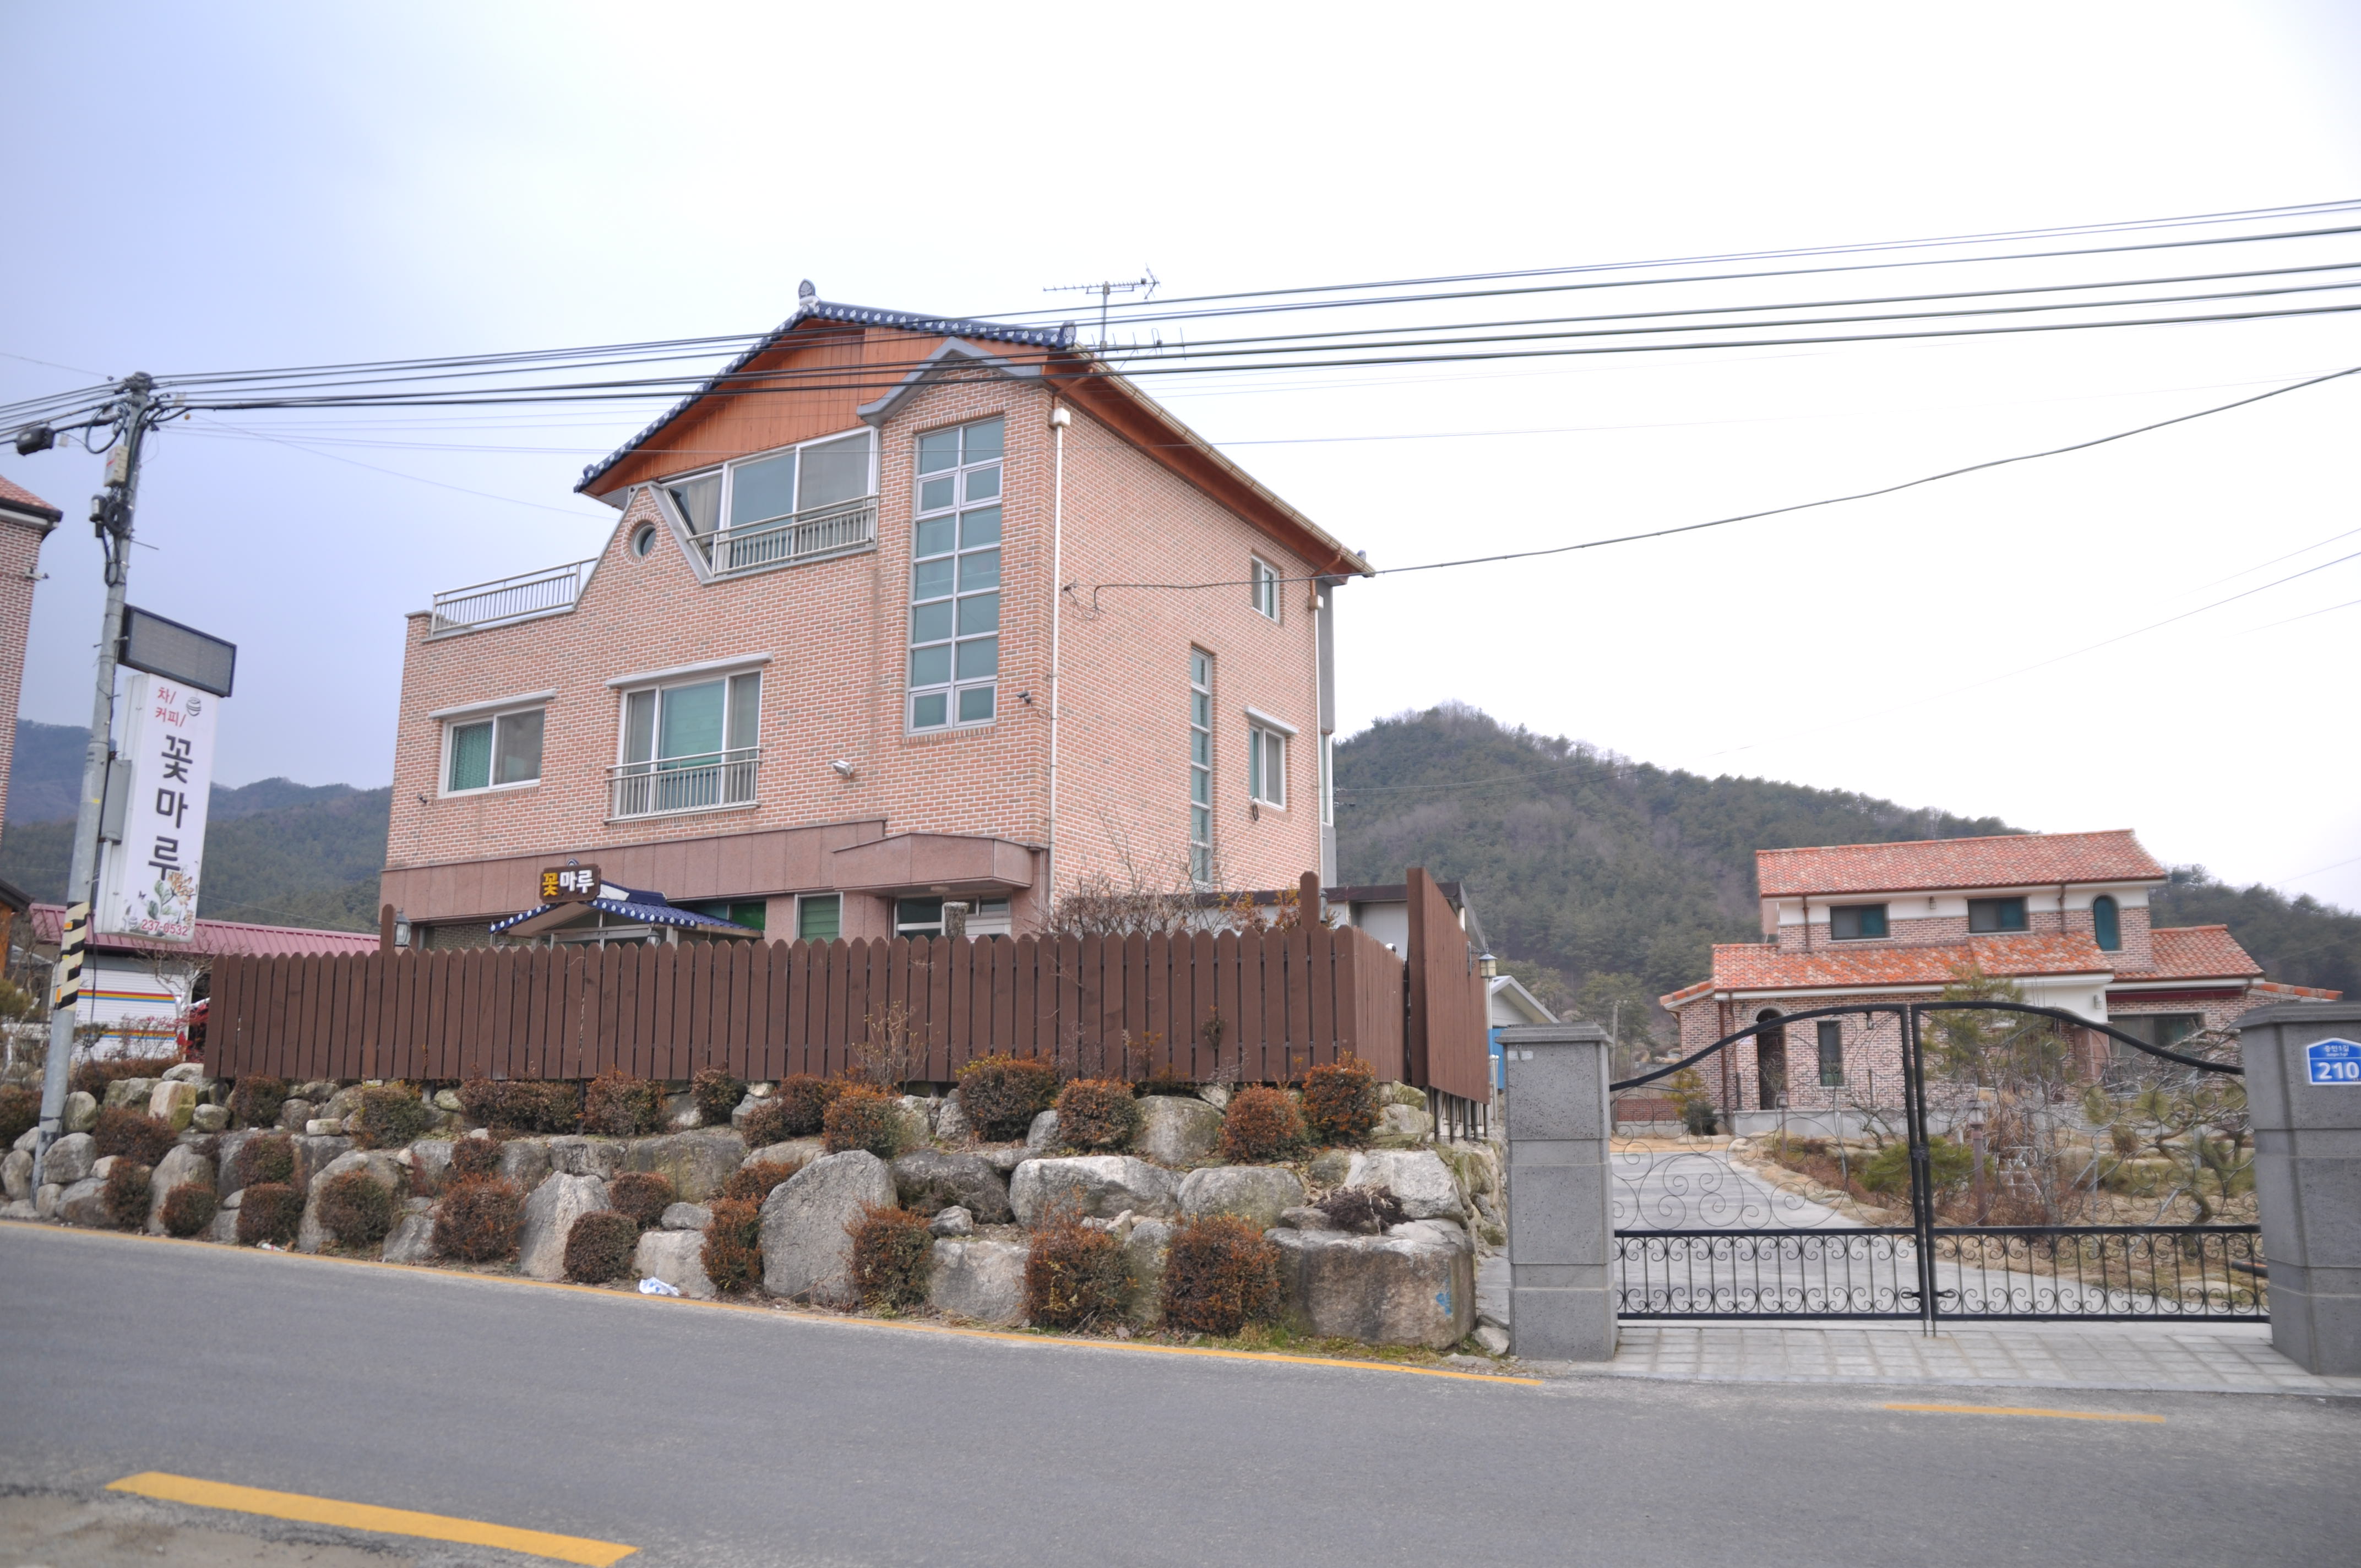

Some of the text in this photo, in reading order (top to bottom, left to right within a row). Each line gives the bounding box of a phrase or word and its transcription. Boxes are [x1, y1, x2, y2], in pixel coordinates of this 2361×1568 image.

[148, 734, 193, 881] 꽃마루
[542, 869, 595, 897] 꽃마루
[141, 919, 188, 936] 237-0532
[2319, 1061, 2360, 1080] 210
